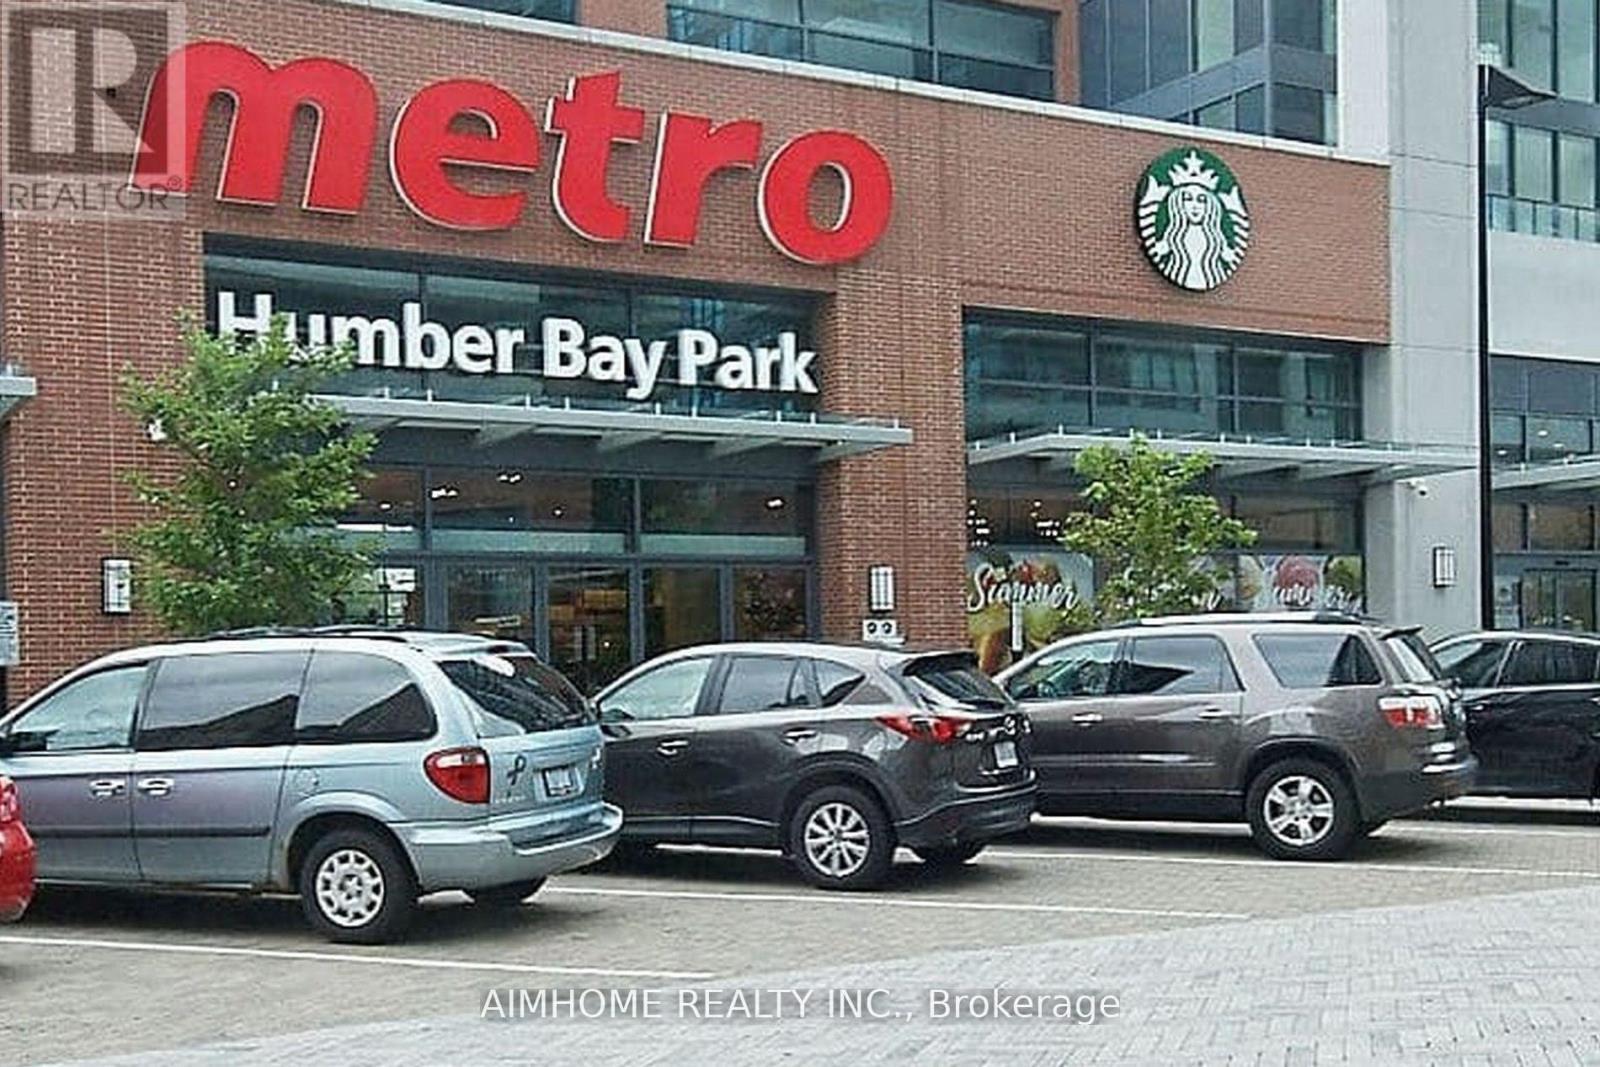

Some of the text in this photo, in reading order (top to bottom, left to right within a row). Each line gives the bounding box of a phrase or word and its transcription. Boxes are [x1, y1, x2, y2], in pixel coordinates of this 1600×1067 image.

[128, 40, 894, 265] metro
[217, 290, 819, 400] Humber Bay Park
